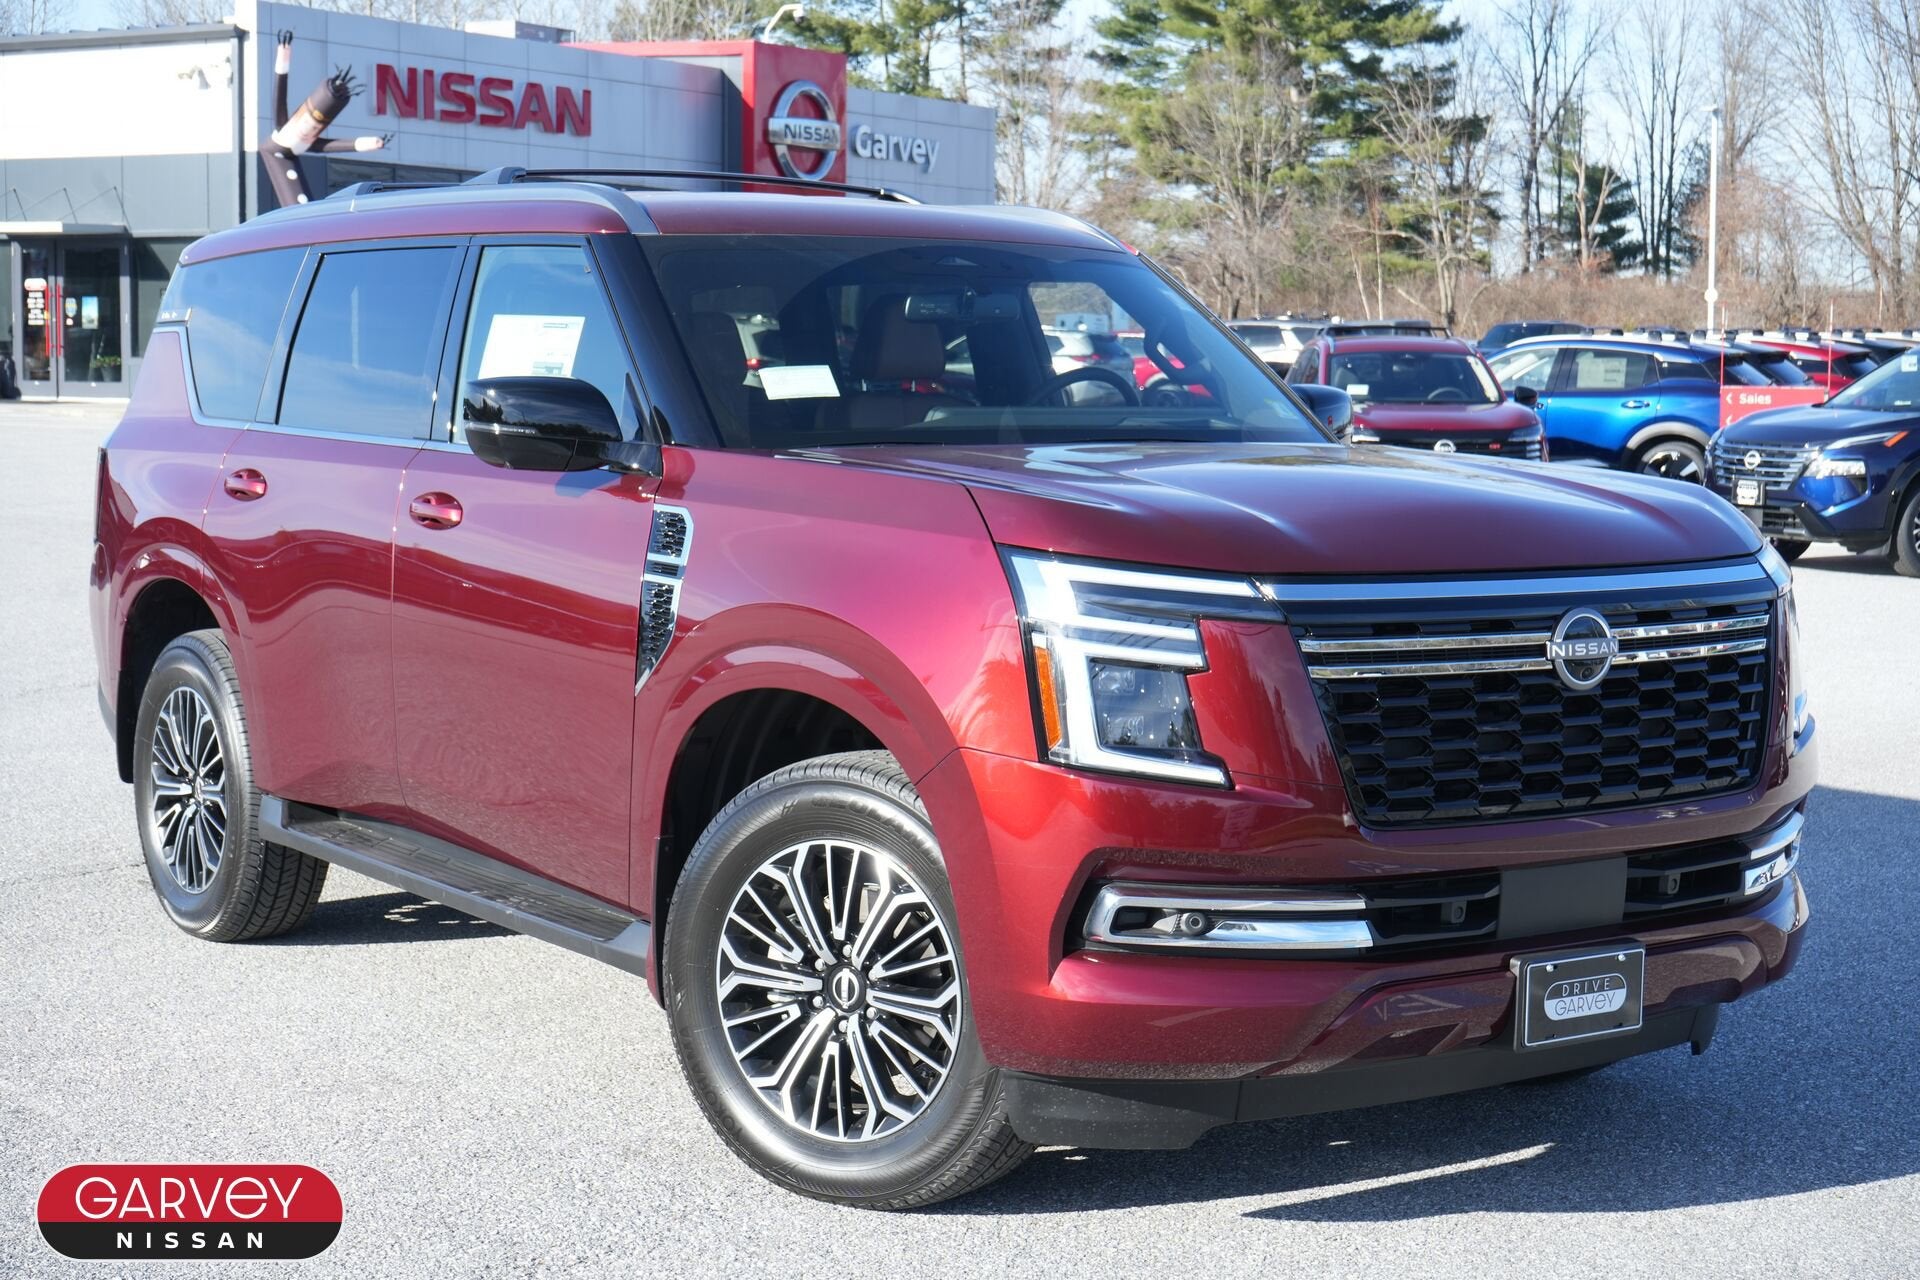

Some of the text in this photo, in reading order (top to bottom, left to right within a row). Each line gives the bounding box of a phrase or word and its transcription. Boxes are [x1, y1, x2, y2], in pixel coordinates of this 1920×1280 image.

[374, 63, 592, 137] NISSAN
[784, 123, 839, 145] NISSAN
[854, 124, 940, 173] Garvey
[1739, 392, 1772, 405] Sales
[1551, 641, 1618, 658] NISSAN
[1562, 977, 1611, 997] DRIVE
